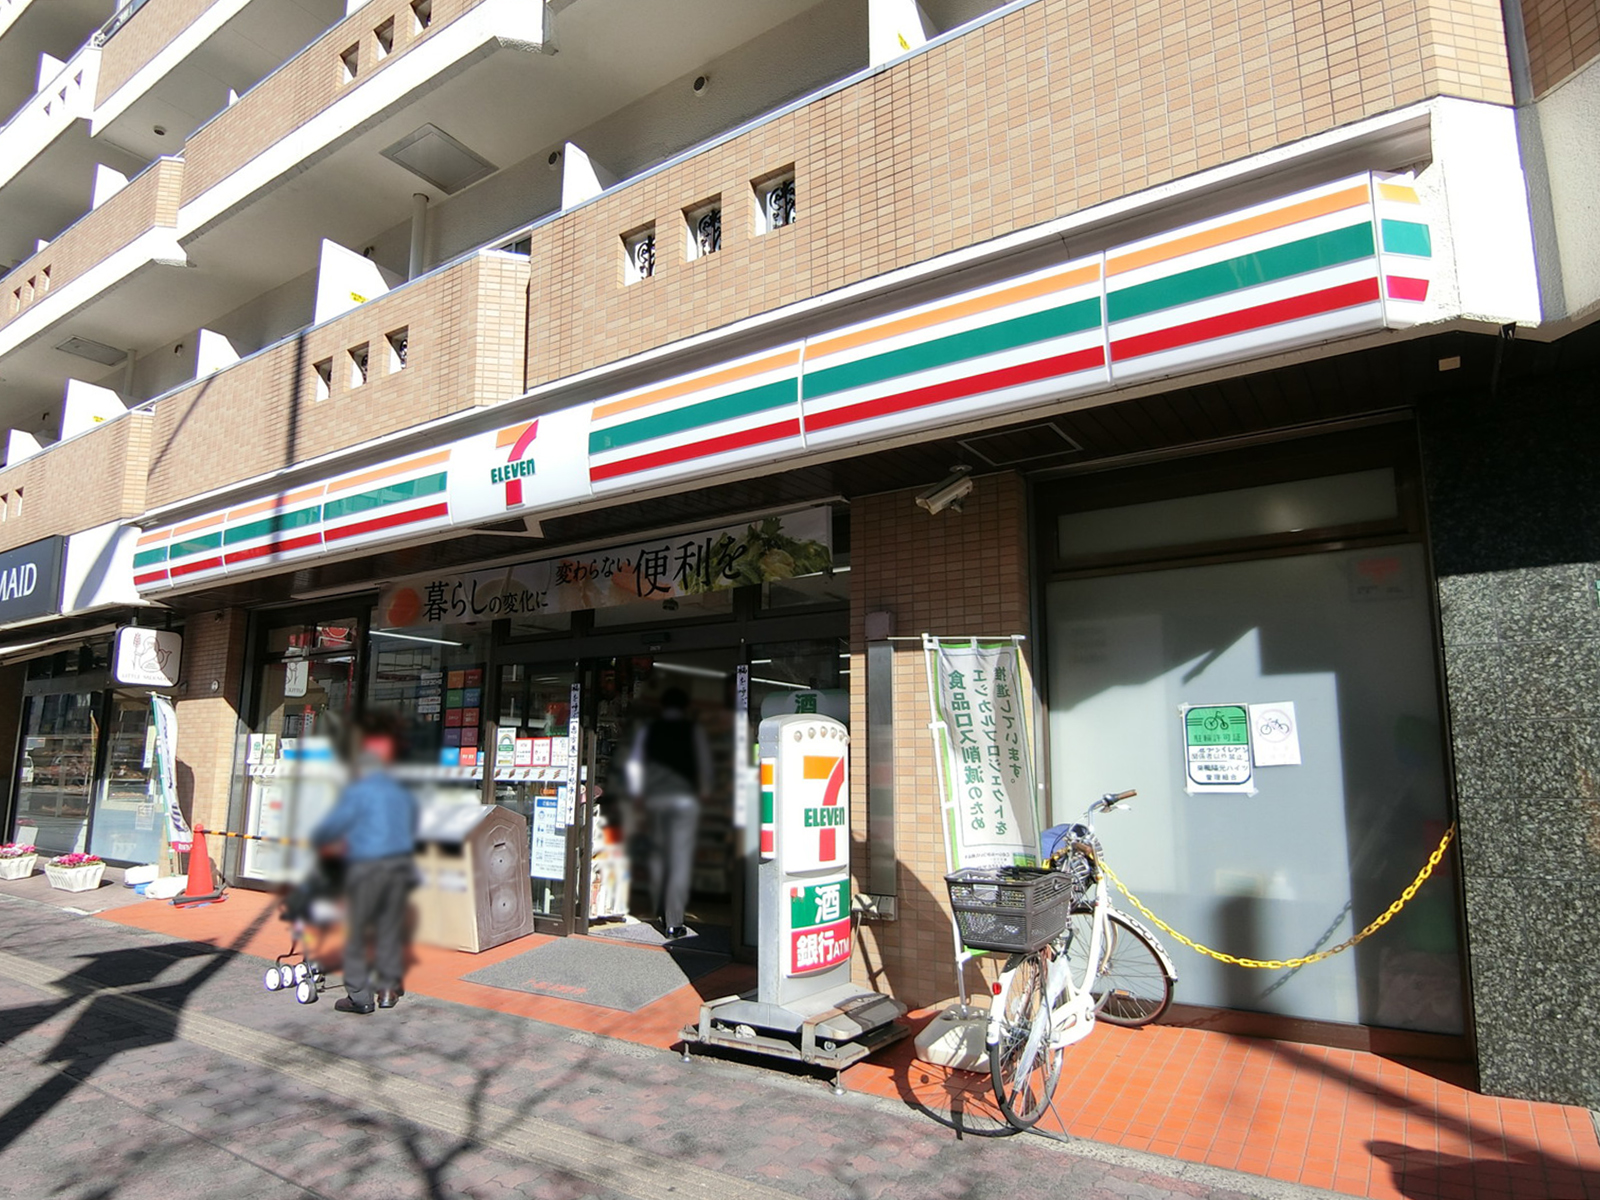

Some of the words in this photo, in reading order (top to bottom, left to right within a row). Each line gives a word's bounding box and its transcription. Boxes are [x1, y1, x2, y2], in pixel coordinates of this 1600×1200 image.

[496, 418, 539, 508] 7
[422, 579, 549, 623] 暮らしの変化に
[803, 755, 845, 862] 7
[814, 884, 841, 925] 酒
